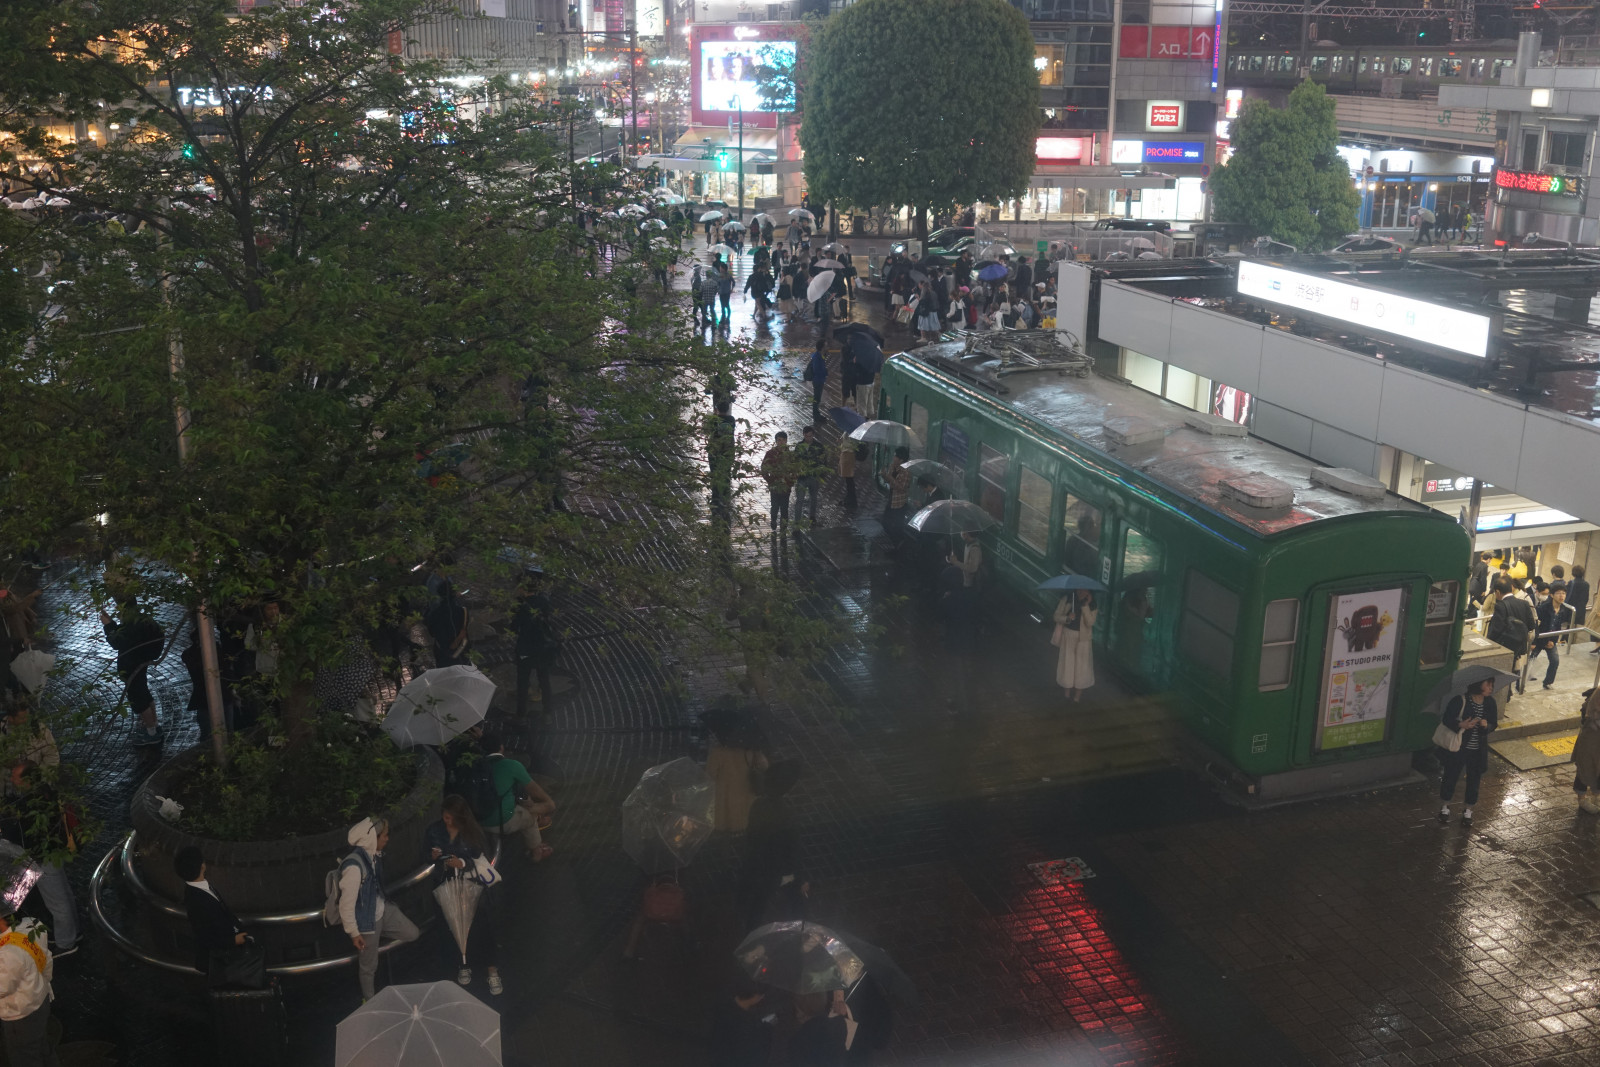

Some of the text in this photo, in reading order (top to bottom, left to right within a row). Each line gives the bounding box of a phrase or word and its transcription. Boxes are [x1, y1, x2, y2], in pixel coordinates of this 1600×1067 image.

[1158, 43, 1181, 55] 入口
[1153, 113, 1176, 122] プロミス
[1437, 109, 1452, 123] JR
[1146, 147, 1183, 157] PROMISE
[1345, 657, 1371, 667] STUDIO
[1371, 654, 1392, 664] PARK
